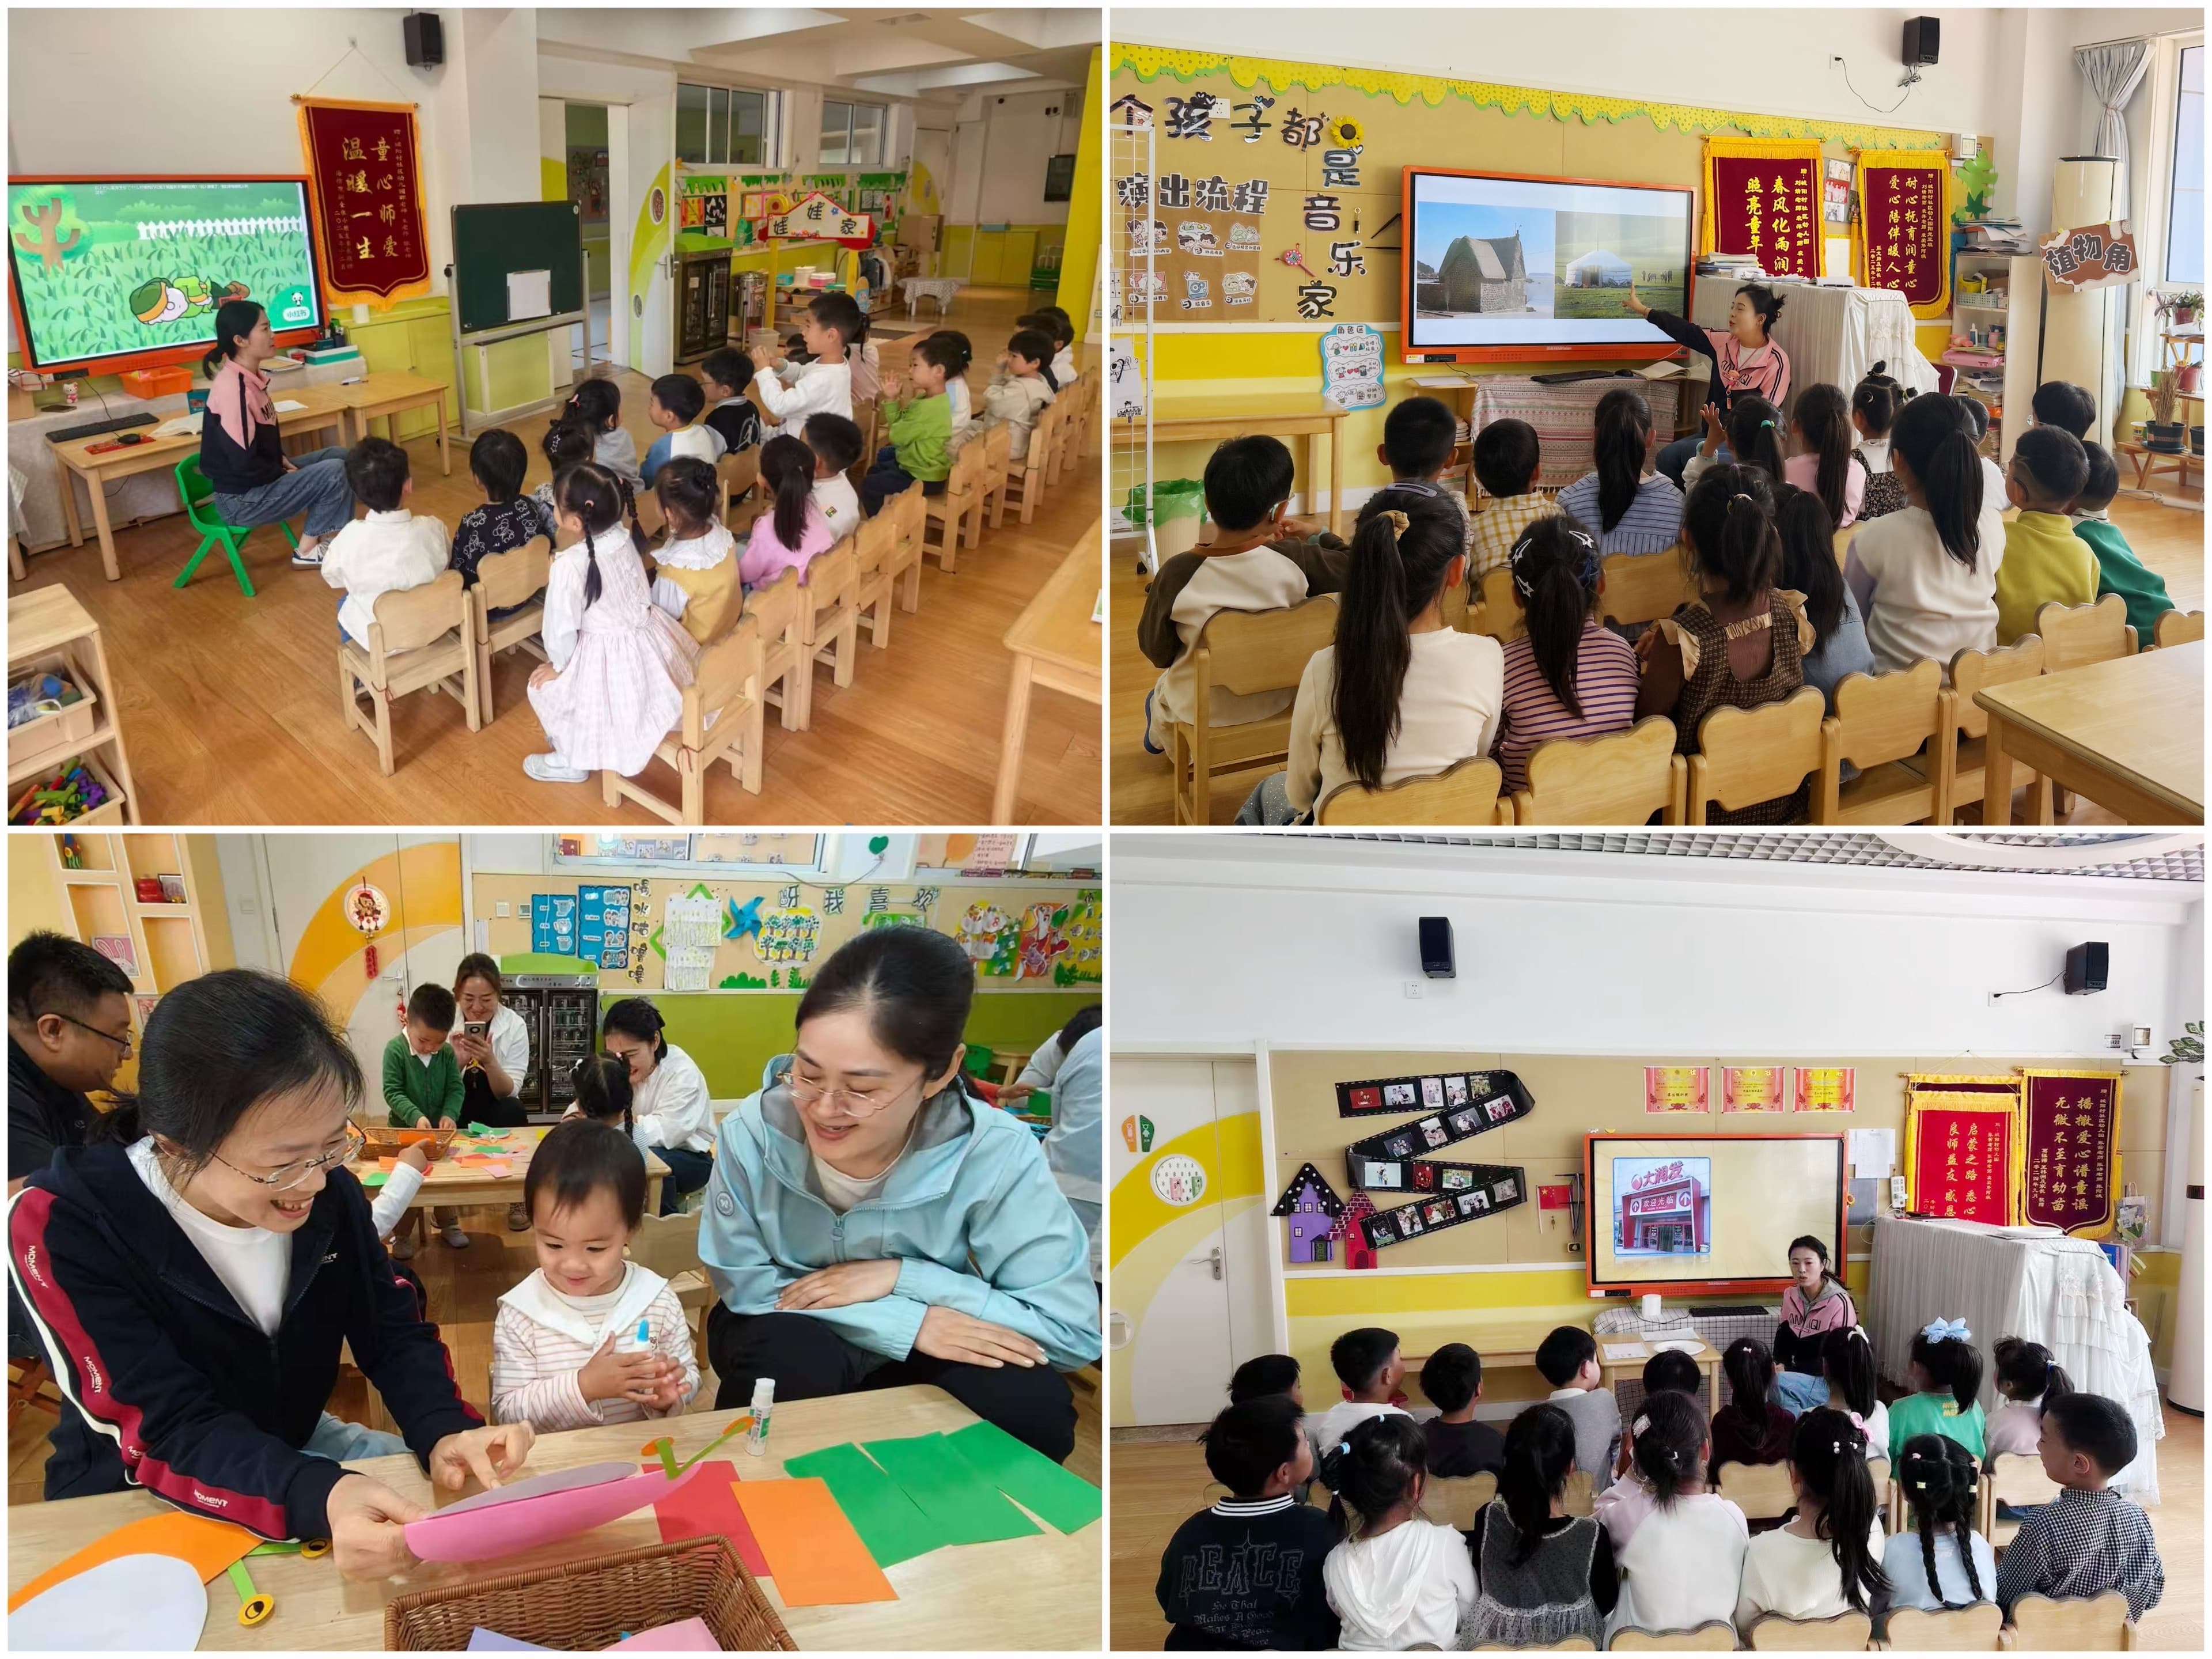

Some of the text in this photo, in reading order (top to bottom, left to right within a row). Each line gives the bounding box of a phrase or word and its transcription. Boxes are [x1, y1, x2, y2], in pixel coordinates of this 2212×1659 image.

[342, 137, 374, 259] 温暖一生
[370, 137, 399, 257] 童心师爱
[773, 202, 857, 235] 娃娃家
[1118, 173, 1268, 215] 演出流程
[1744, 176, 1763, 268] 照亮童年
[1770, 175, 1790, 278] 春风化雨润
[1885, 175, 1901, 289] 爱心陪伴暖人心
[1904, 176, 1918, 288] 耐心抚育润童心
[2046, 233, 2131, 276] 植物角
[1338, 325, 1363, 334] 角色区
[1643, 1161, 1683, 1187] 大润发
[1945, 1122, 1960, 1217] 良师益友 感恩
[1965, 1123, 1979, 1180] 启蒙之路
[2051, 1096, 2071, 1211] 无微不至育幼苗
[2071, 1097, 2094, 1210] 播撒爱心谱童谣
[1643, 1195, 1673, 1207] 欢迎光临
[28, 1245, 48, 1289] MOMENT
[84, 1356, 101, 1393] MOMENT
[1179, 1543, 1304, 1599] PEACE
